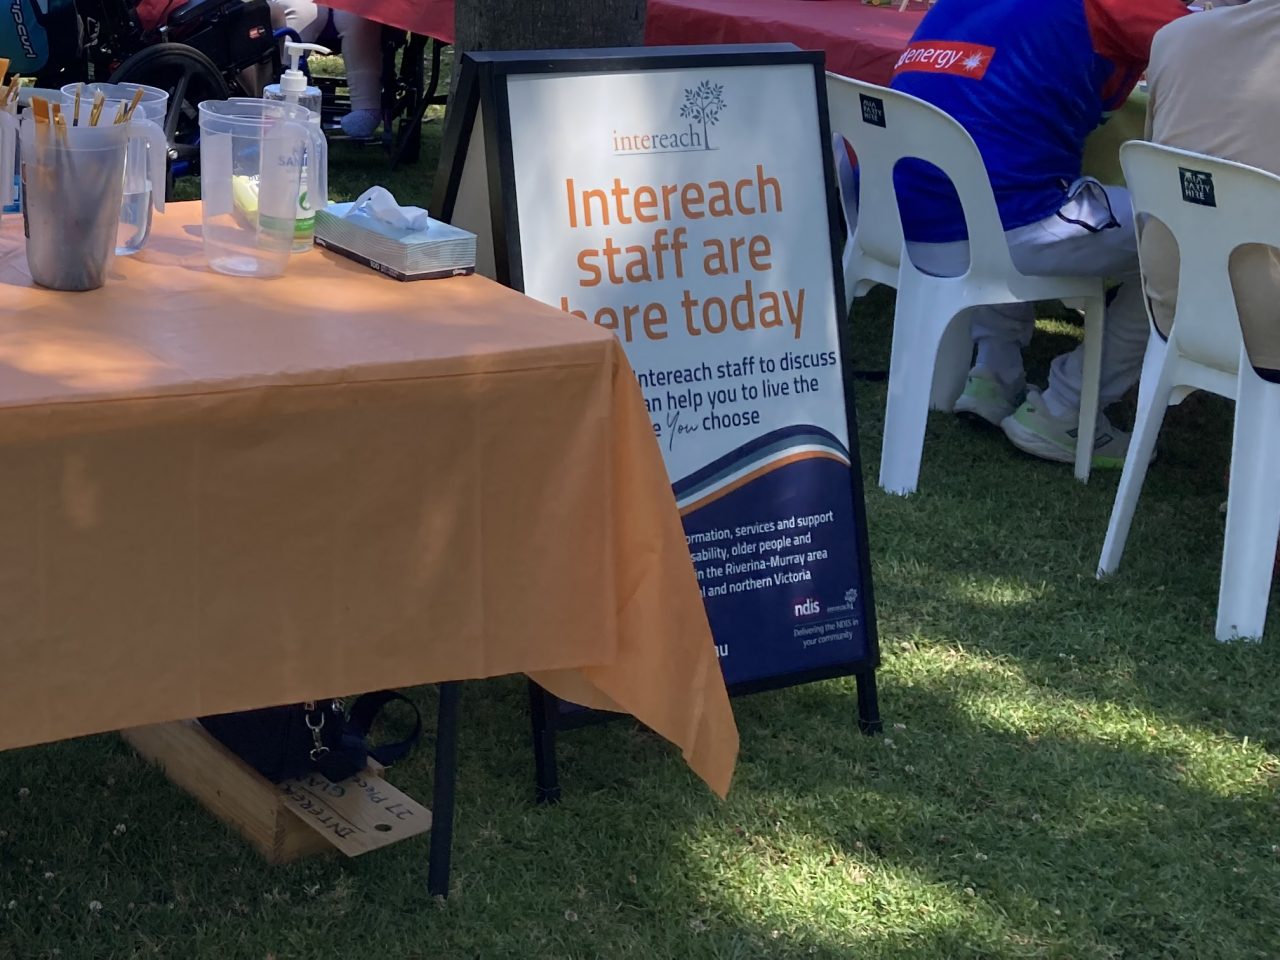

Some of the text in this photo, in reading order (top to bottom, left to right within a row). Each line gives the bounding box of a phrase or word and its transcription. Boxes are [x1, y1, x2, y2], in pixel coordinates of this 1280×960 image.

[613, 124, 701, 151] intereach
[566, 164, 783, 228] Intereach
[576, 227, 772, 287] staff are
[681, 280, 805, 340] today
[633, 351, 837, 387] ntereach staff to discuss
[666, 388, 703, 412] help
[707, 388, 737, 410] you
[741, 383, 758, 400] to
[762, 379, 790, 398] live
[793, 375, 819, 394] the
[666, 410, 698, 452] You
[702, 410, 760, 431] choose
[735, 521, 776, 537] services
[777, 515, 795, 530] and
[797, 510, 833, 528] support
[731, 542, 757, 556] older
[759, 535, 792, 554] people
[793, 531, 812, 545] and
[706, 566, 724, 579] the
[725, 553, 805, 575] Riverina-Murray
[807, 549, 828, 562] area
[707, 582, 728, 597] and
[729, 577, 773, 593] northern
[773, 569, 812, 585] Victoria
[794, 598, 820, 617] ndis
